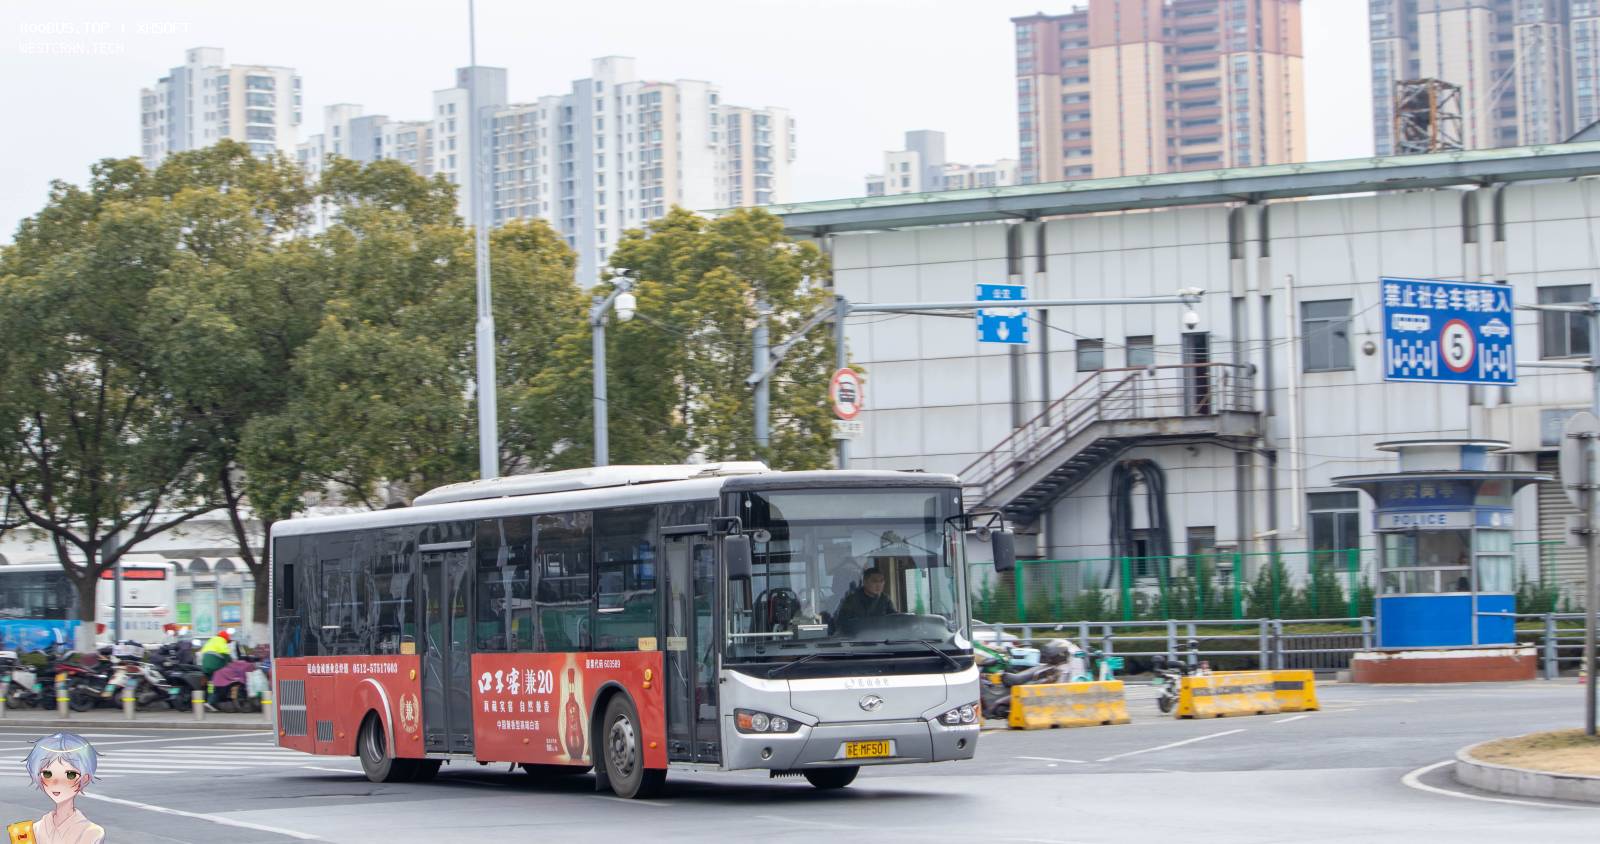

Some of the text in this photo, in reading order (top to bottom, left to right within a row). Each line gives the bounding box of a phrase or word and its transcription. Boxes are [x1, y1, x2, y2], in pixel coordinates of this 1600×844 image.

[1451, 333, 1464, 361] 5
[1391, 482, 1457, 499] 安岗亭
[1393, 513, 1447, 526] POLICE
